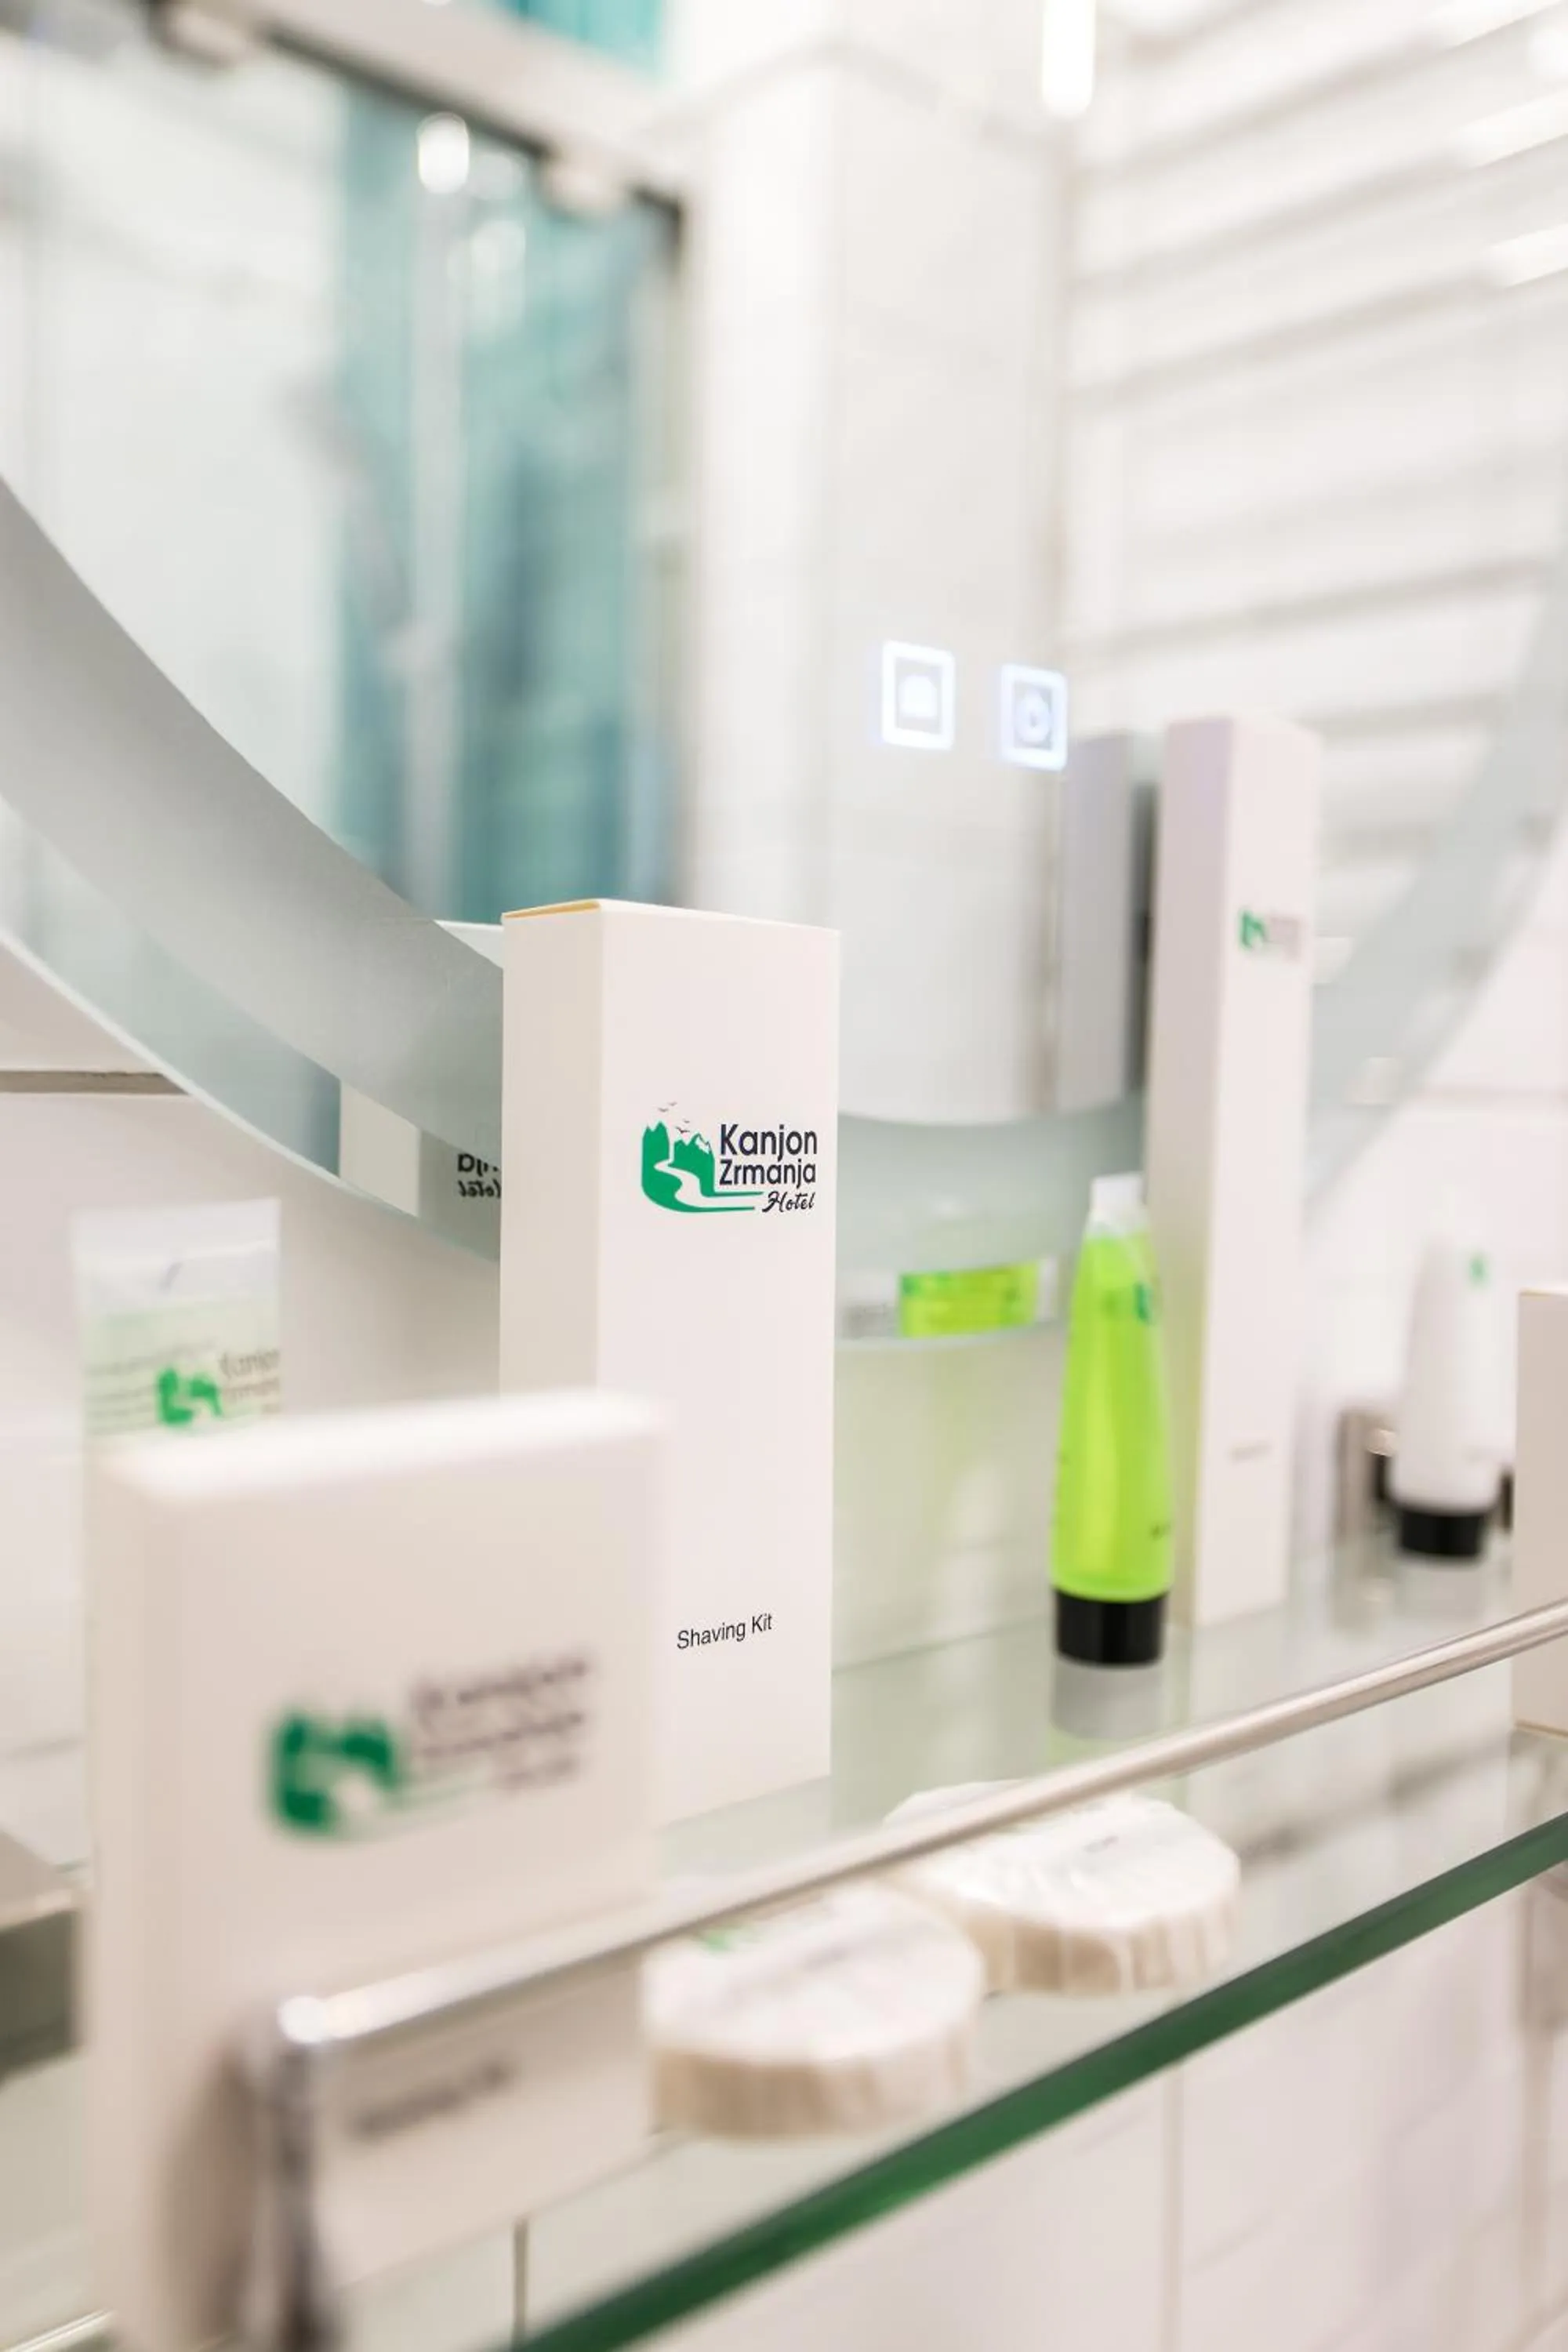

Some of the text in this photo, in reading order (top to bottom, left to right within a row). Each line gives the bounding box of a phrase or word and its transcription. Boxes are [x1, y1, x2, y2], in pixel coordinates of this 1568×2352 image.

[720, 1123, 818, 1161] Kanjon
[719, 1158, 816, 1189] Zrmanja
[761, 1191, 816, 1213] Hotel
[677, 1613, 773, 1650] Shaving Kit
